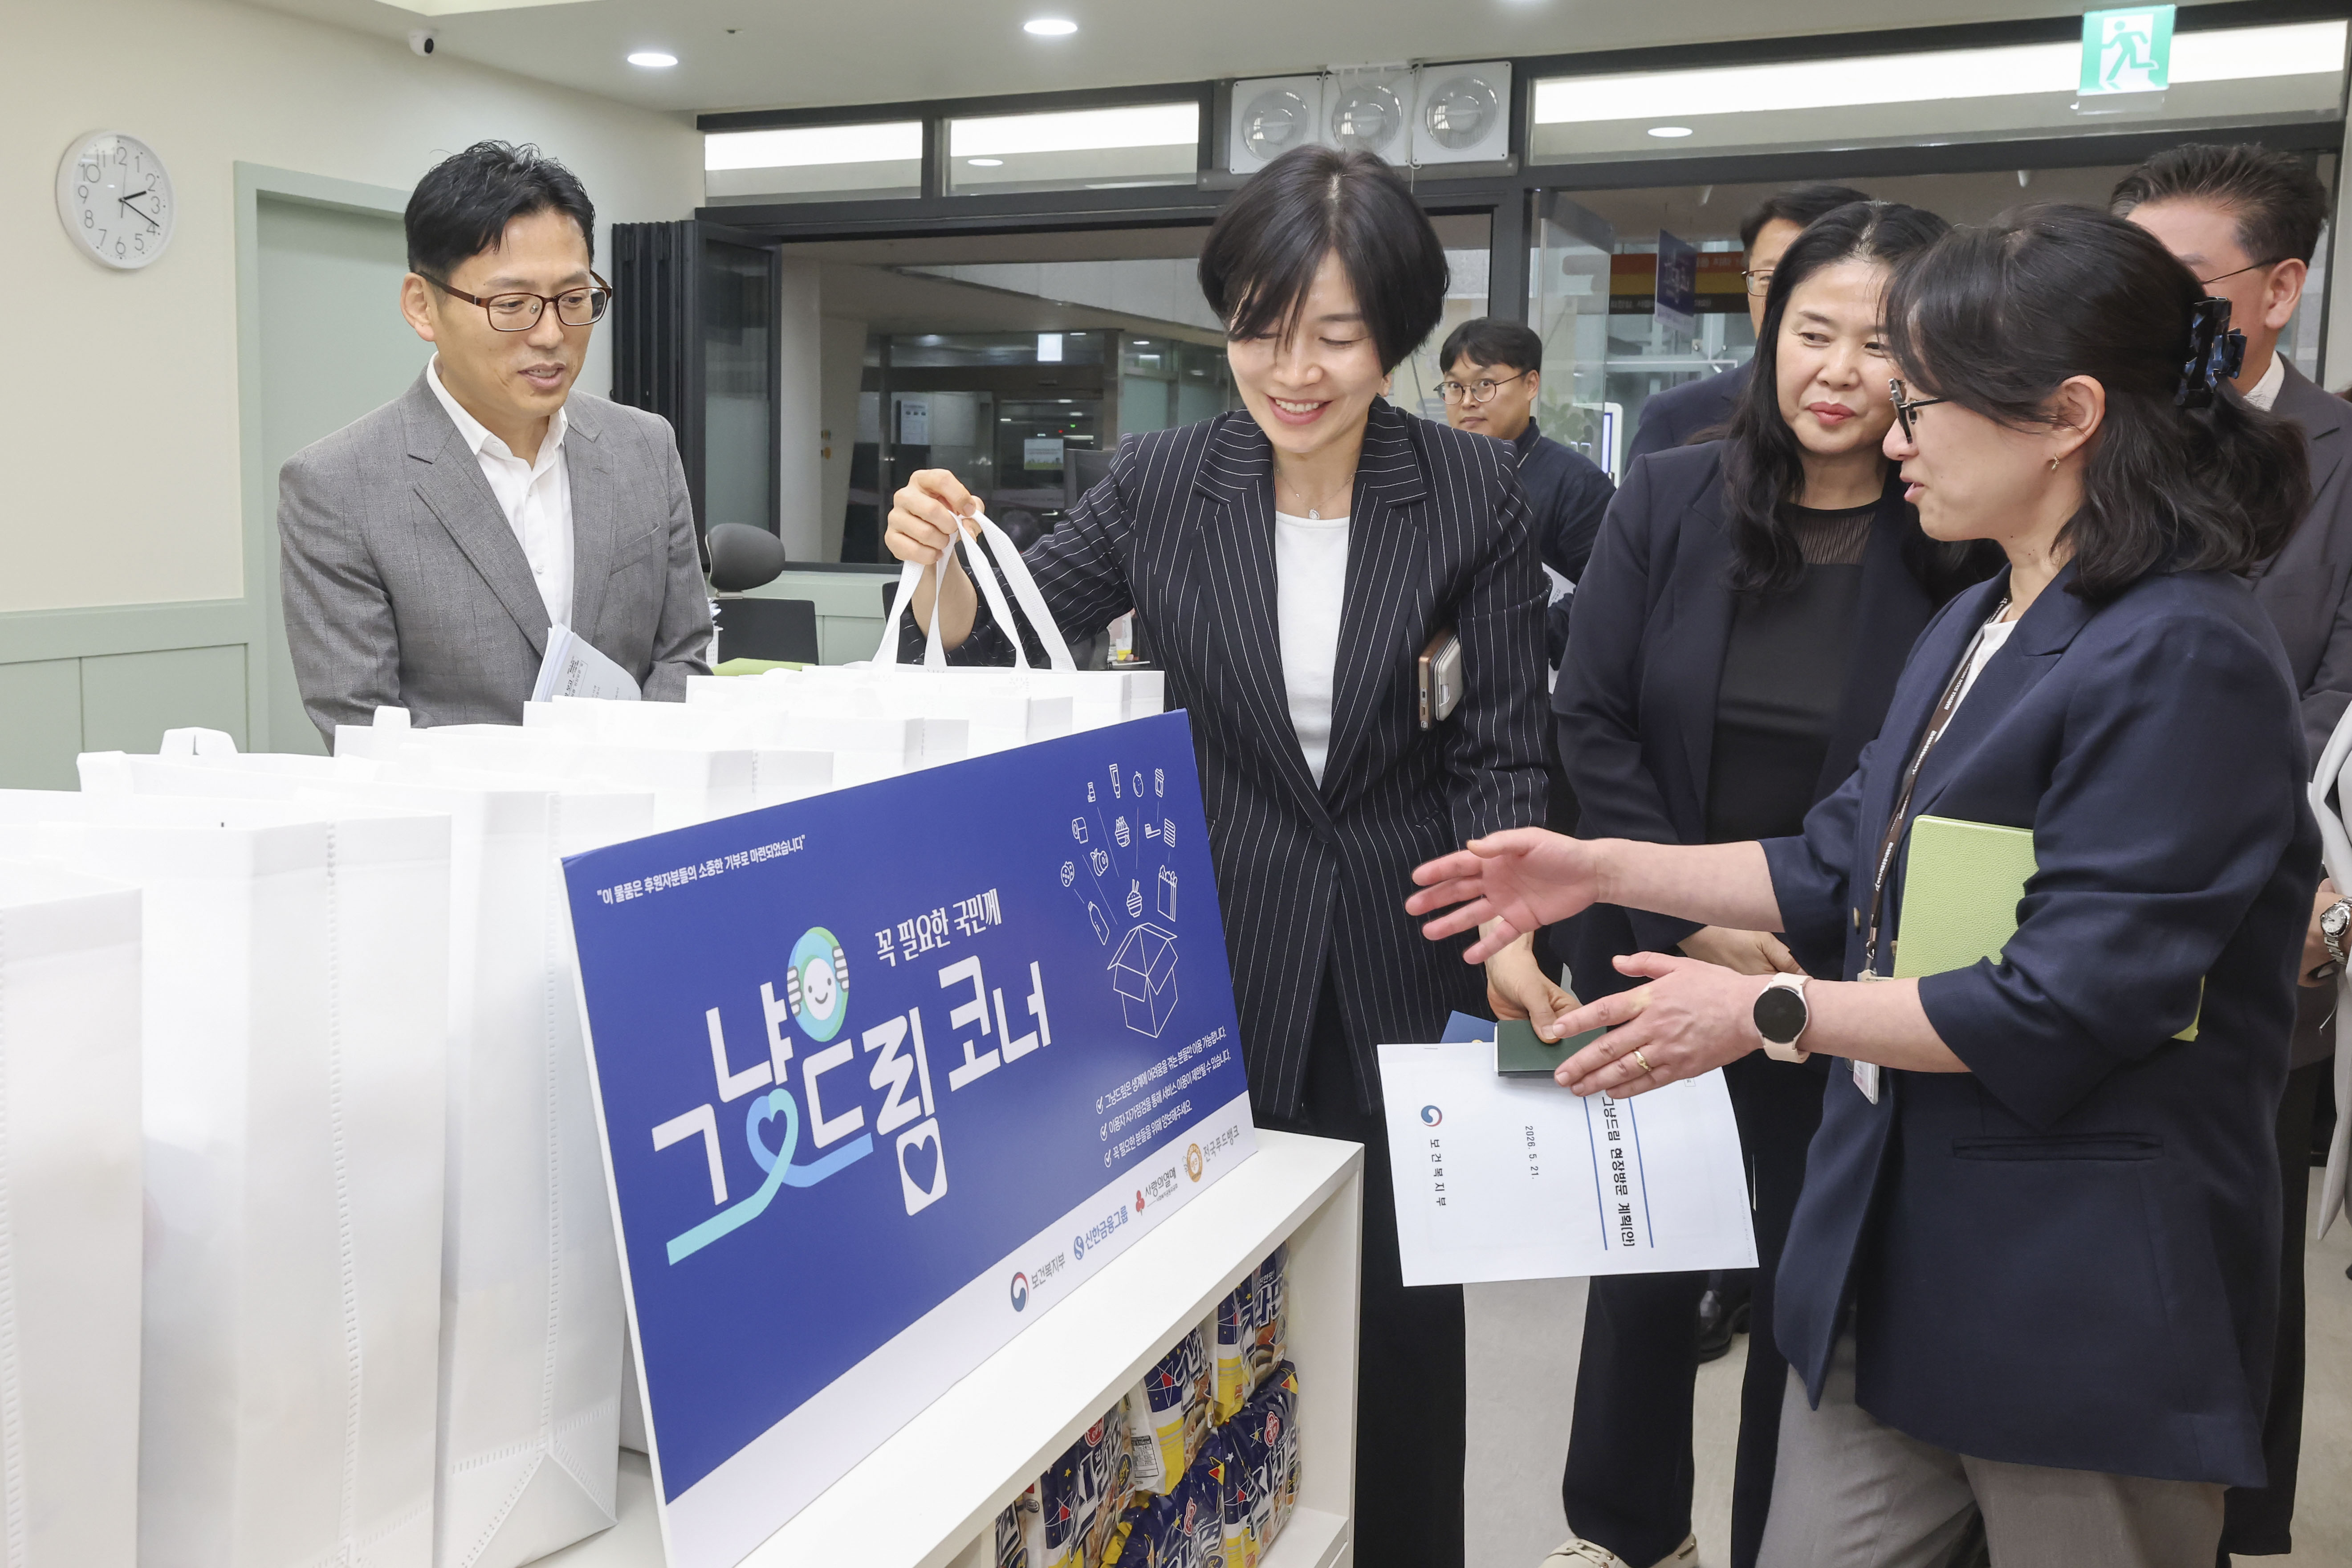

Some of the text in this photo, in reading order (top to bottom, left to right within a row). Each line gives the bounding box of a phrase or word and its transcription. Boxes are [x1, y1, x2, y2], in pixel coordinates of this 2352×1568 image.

[96, 149, 106, 168] 11
[113, 147, 127, 166] 12
[135, 155, 140, 173] 1
[78, 163, 101, 183] 10
[146, 173, 156, 192] 2
[78, 185, 89, 204] 9
[151, 196, 160, 214] 3
[85, 209, 94, 228] 8
[98, 228, 107, 246] 7
[115, 236, 126, 255] 6
[134, 233, 144, 251] 5
[1953, 680, 1963, 693] SOCIAL
[597, 834, 806, 904] "이 물품은 후원자분들의 소중한 기부로 마련되었습니다"
[875, 888, 1002, 967] 꼭 필요한 국민께
[1105, 1025, 1227, 1108] 그냥드림은 생계에 어려움을 겪는 분들만 이용 가능합니다.
[1108, 1048, 1231, 1133] 이용자 자가점검을 통해 서비스 이용이 제한될 수 있습니다.
[651, 955, 1051, 1265] 그냥드림 코너
[1602, 1096, 1621, 1141] 그냥드림
[1113, 1146, 1119, 1160] 꼭
[1119, 1135, 1136, 1157] 필요한
[1135, 1124, 1152, 1146] 분들을
[1152, 1118, 1163, 1133] 위해
[1203, 1124, 1239, 1163] 전국푸드뱅크
[1525, 1126, 1535, 1149] 2026.
[1530, 1166, 1539, 1179] 21.
[1145, 1166, 1177, 1197] 사랑의열매
[1610, 1148, 1628, 1196] 현장방문
[1085, 1205, 1128, 1250] 신한금융그룹
[1031, 1252, 1066, 1290] 보건복지부
